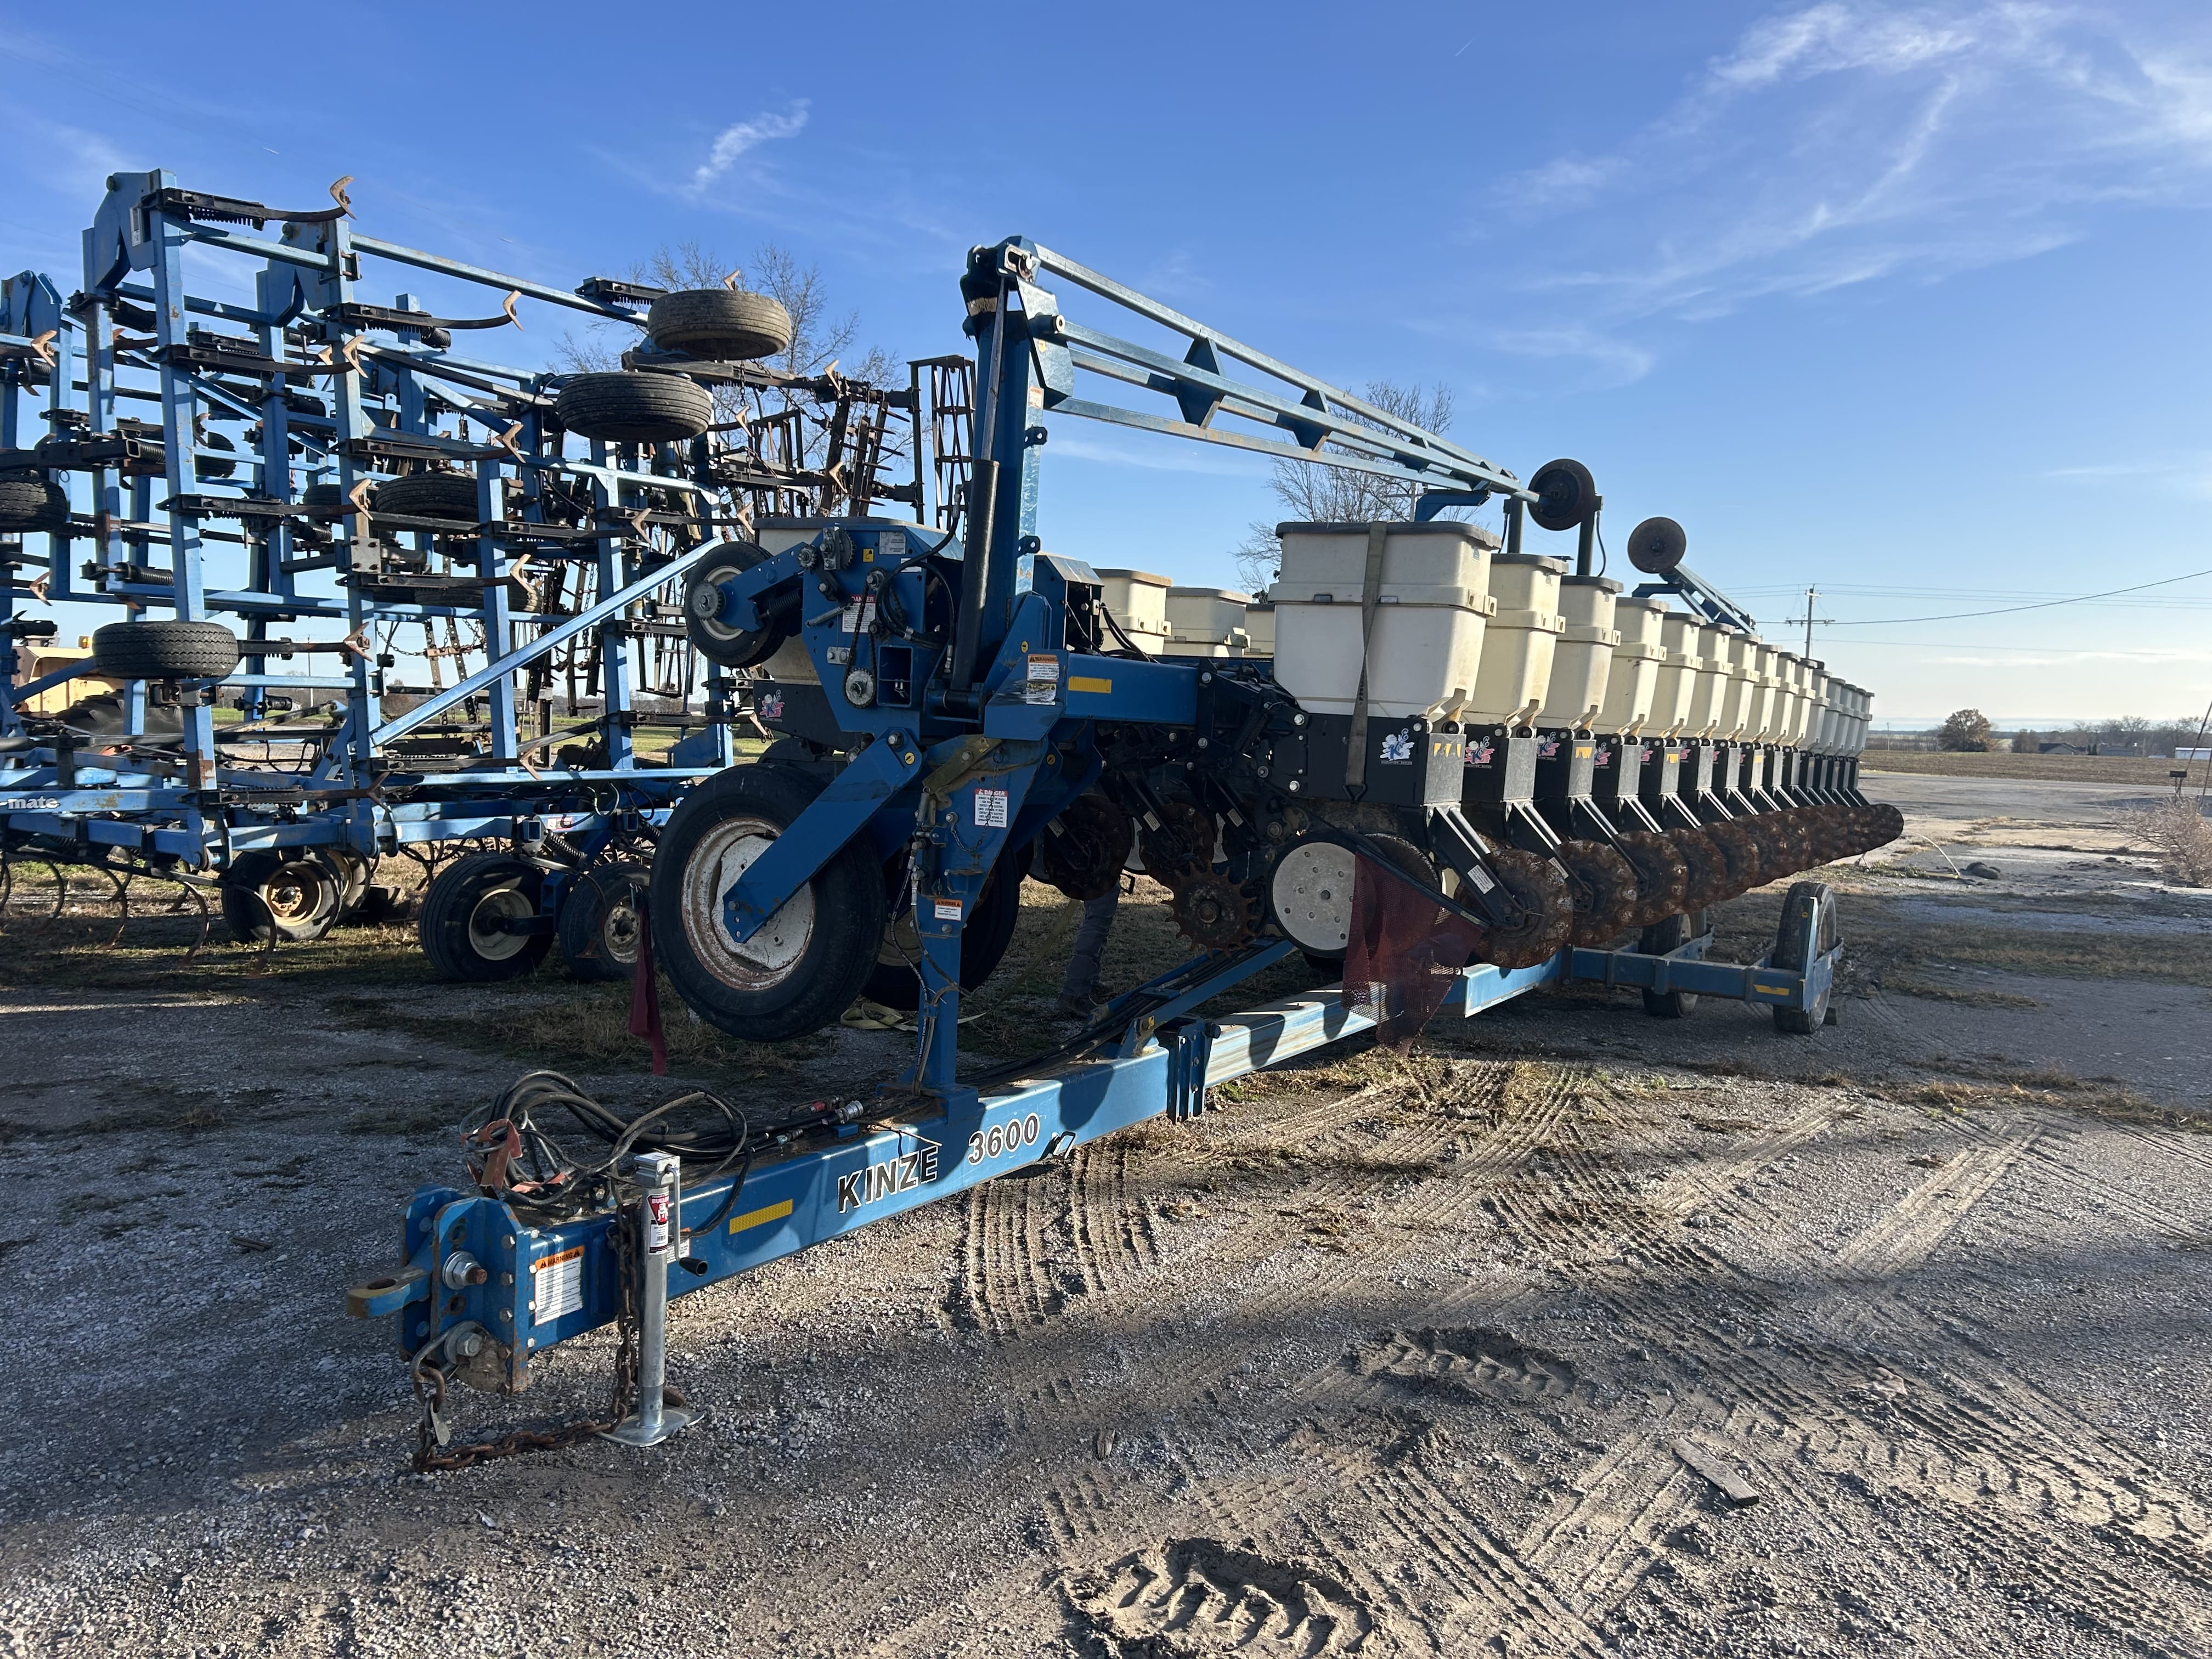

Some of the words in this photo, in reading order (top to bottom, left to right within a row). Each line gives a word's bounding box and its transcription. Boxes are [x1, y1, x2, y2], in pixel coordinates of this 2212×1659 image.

[968, 1112, 1040, 1165] 3600
[837, 1145, 939, 1214] KINZE
[548, 1252, 573, 1266] WARNING
